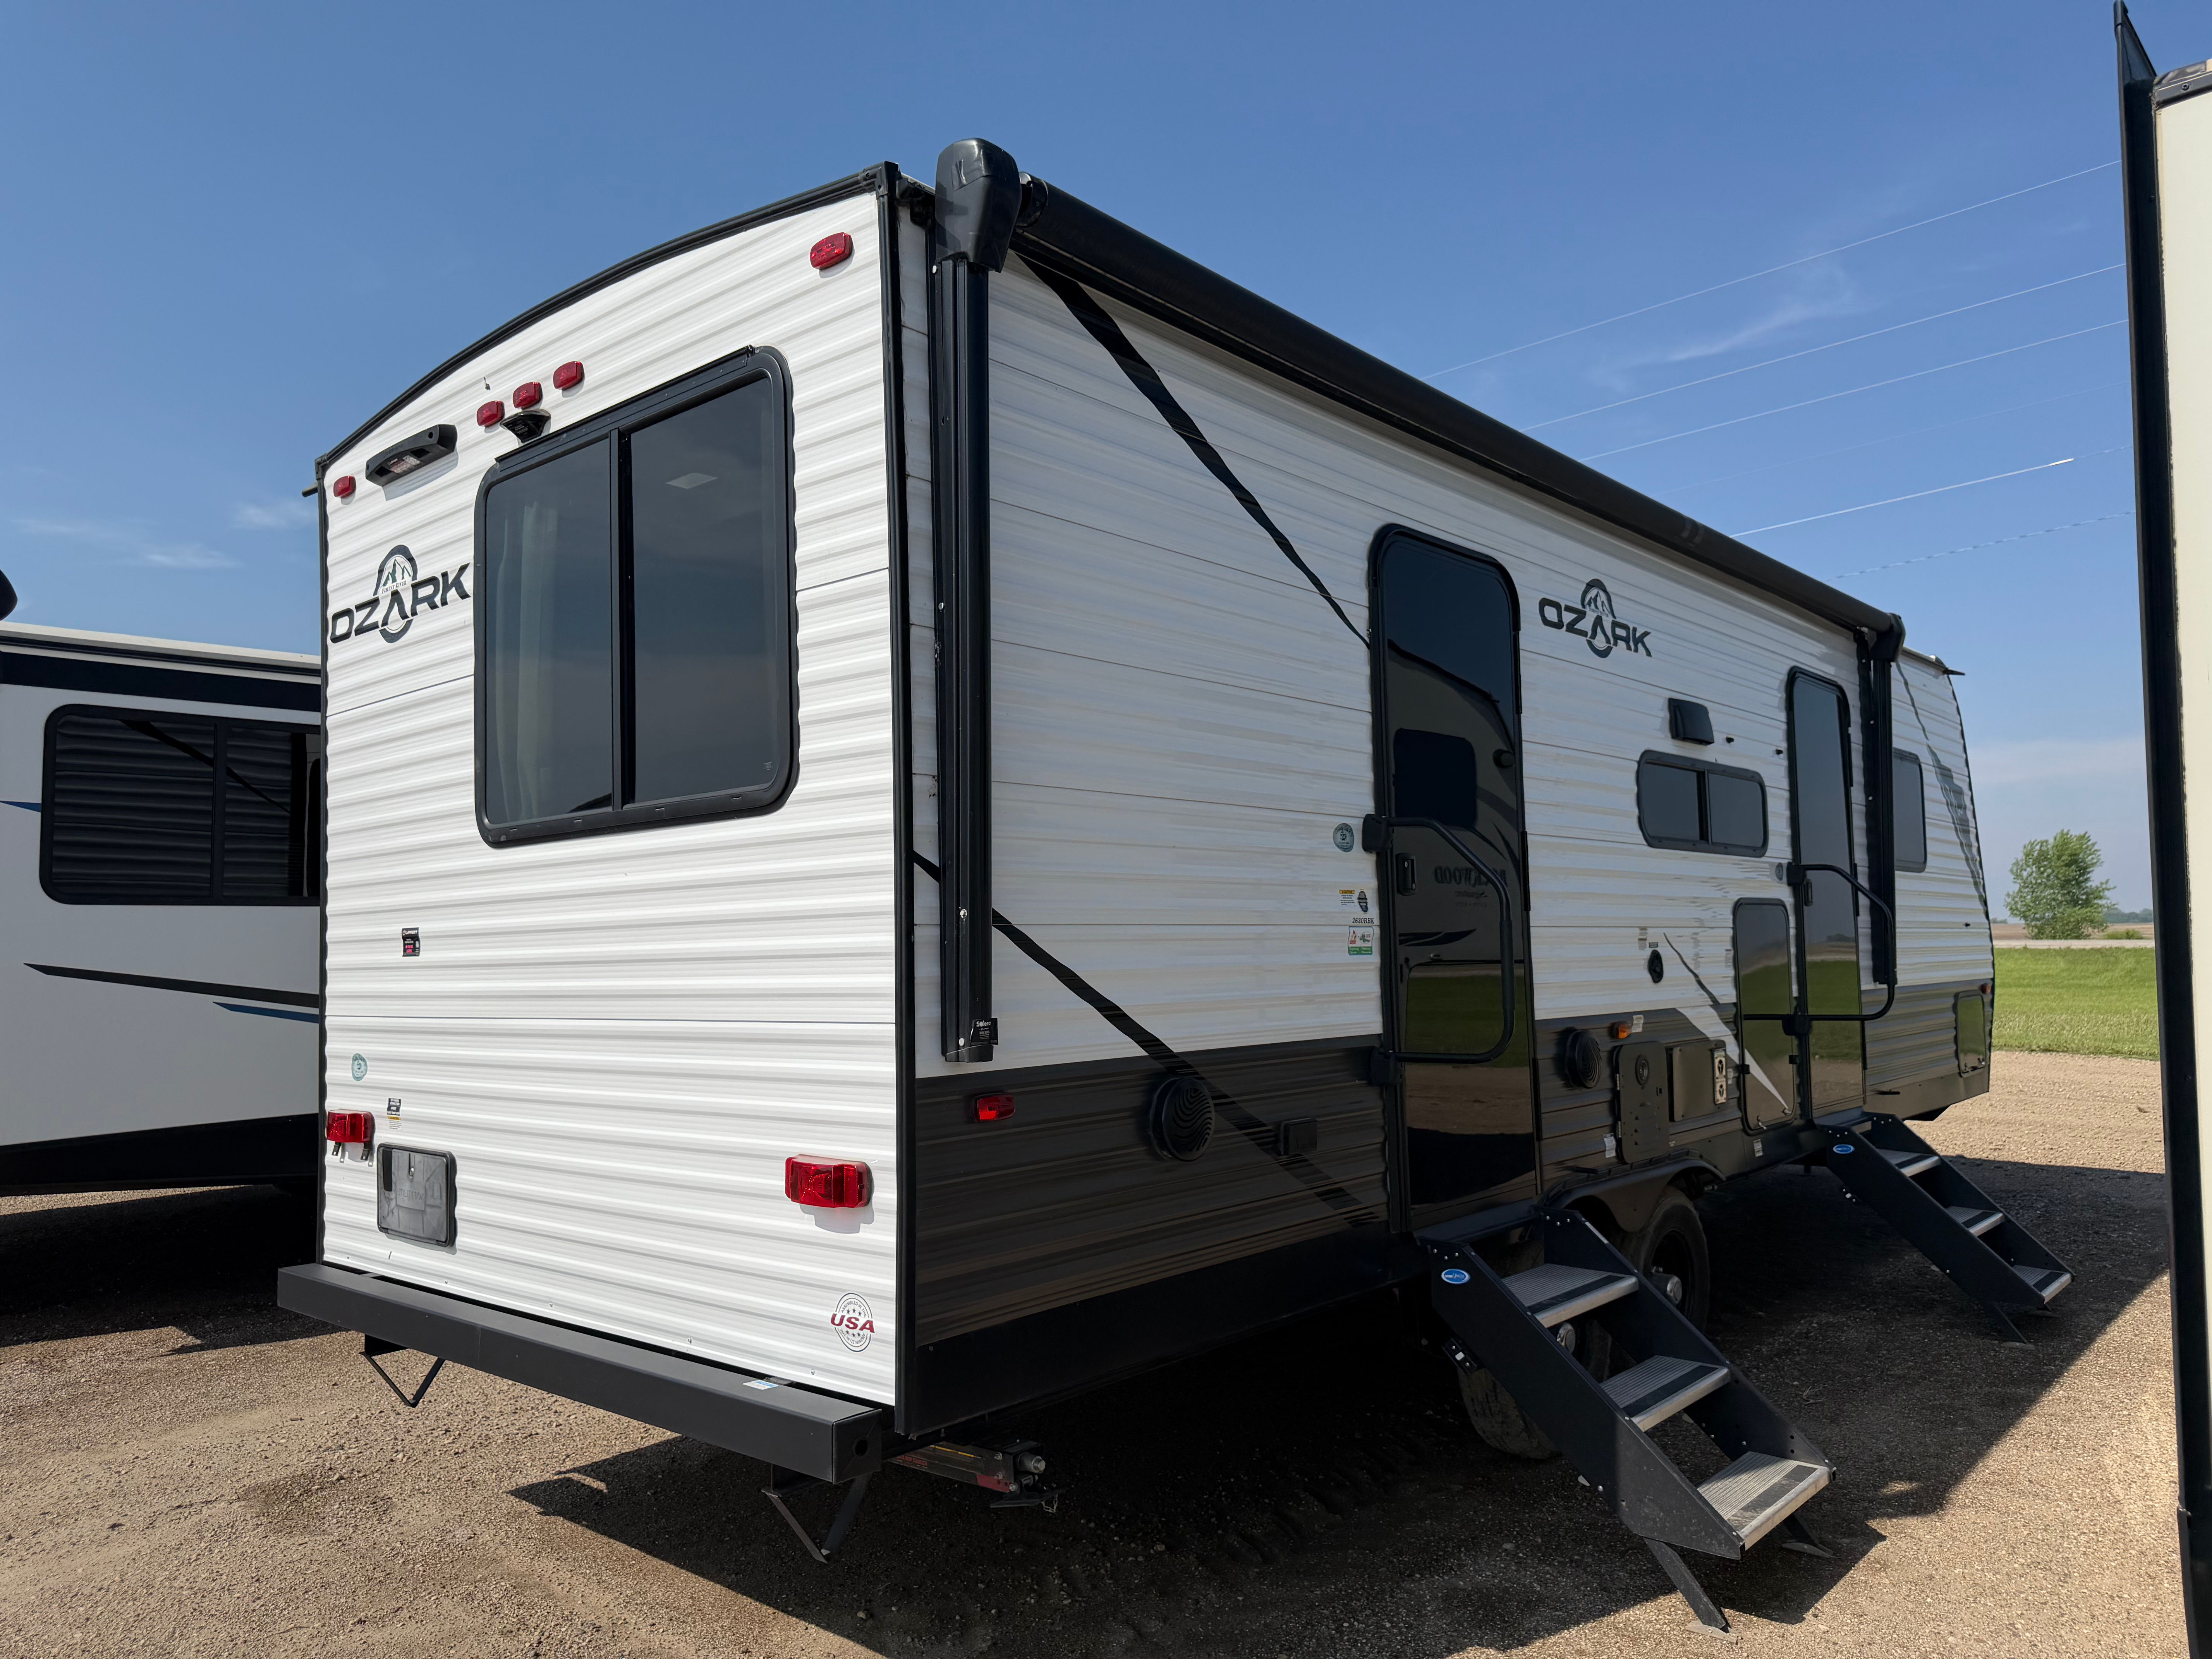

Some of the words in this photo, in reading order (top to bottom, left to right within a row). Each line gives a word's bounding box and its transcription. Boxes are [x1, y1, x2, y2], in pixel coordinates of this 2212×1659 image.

[330, 562, 471, 643] OZARK
[1539, 597, 1652, 657] OZARK
[830, 1313, 875, 1333] USA
[842, 1300, 858, 1313] ASSEMBLED
